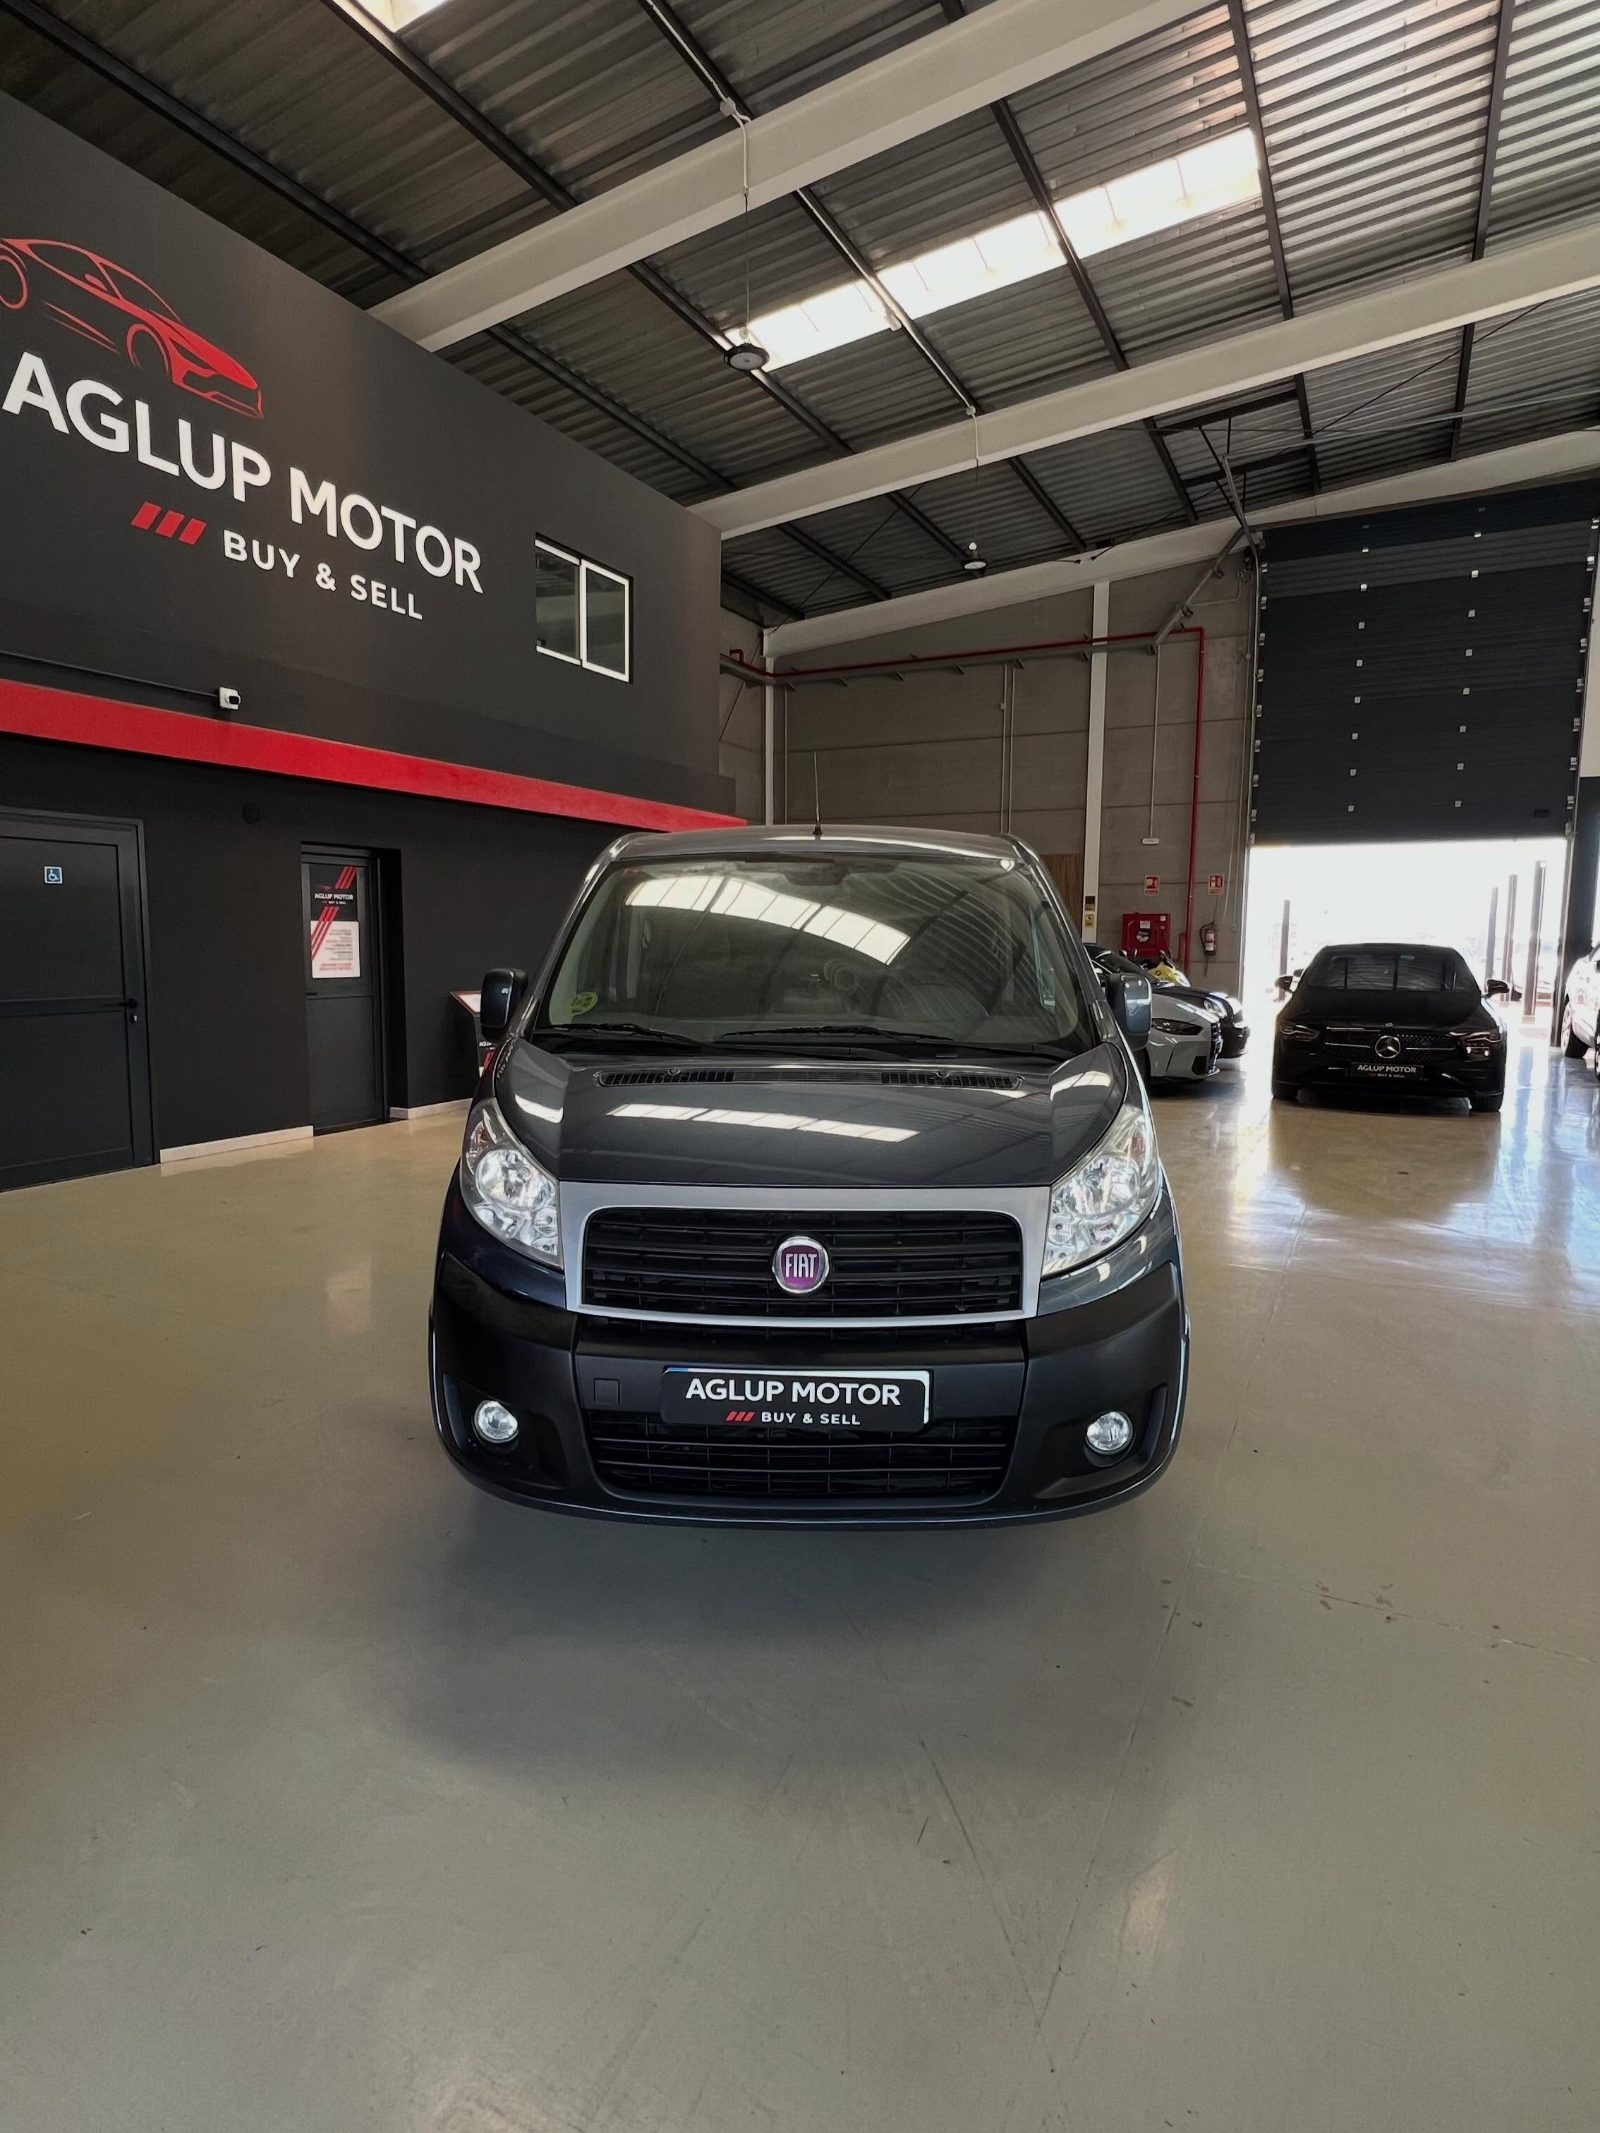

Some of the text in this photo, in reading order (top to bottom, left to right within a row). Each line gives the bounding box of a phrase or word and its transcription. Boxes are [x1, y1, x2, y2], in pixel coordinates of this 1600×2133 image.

[2, 351, 484, 594] AGLUP MOTOR
[223, 529, 423, 621] BUY & SELL
[785, 1253, 818, 1278] FIAT
[685, 1378, 901, 1406] AGLUP MOTOR
[761, 1411, 861, 1426] BUY & SELL
